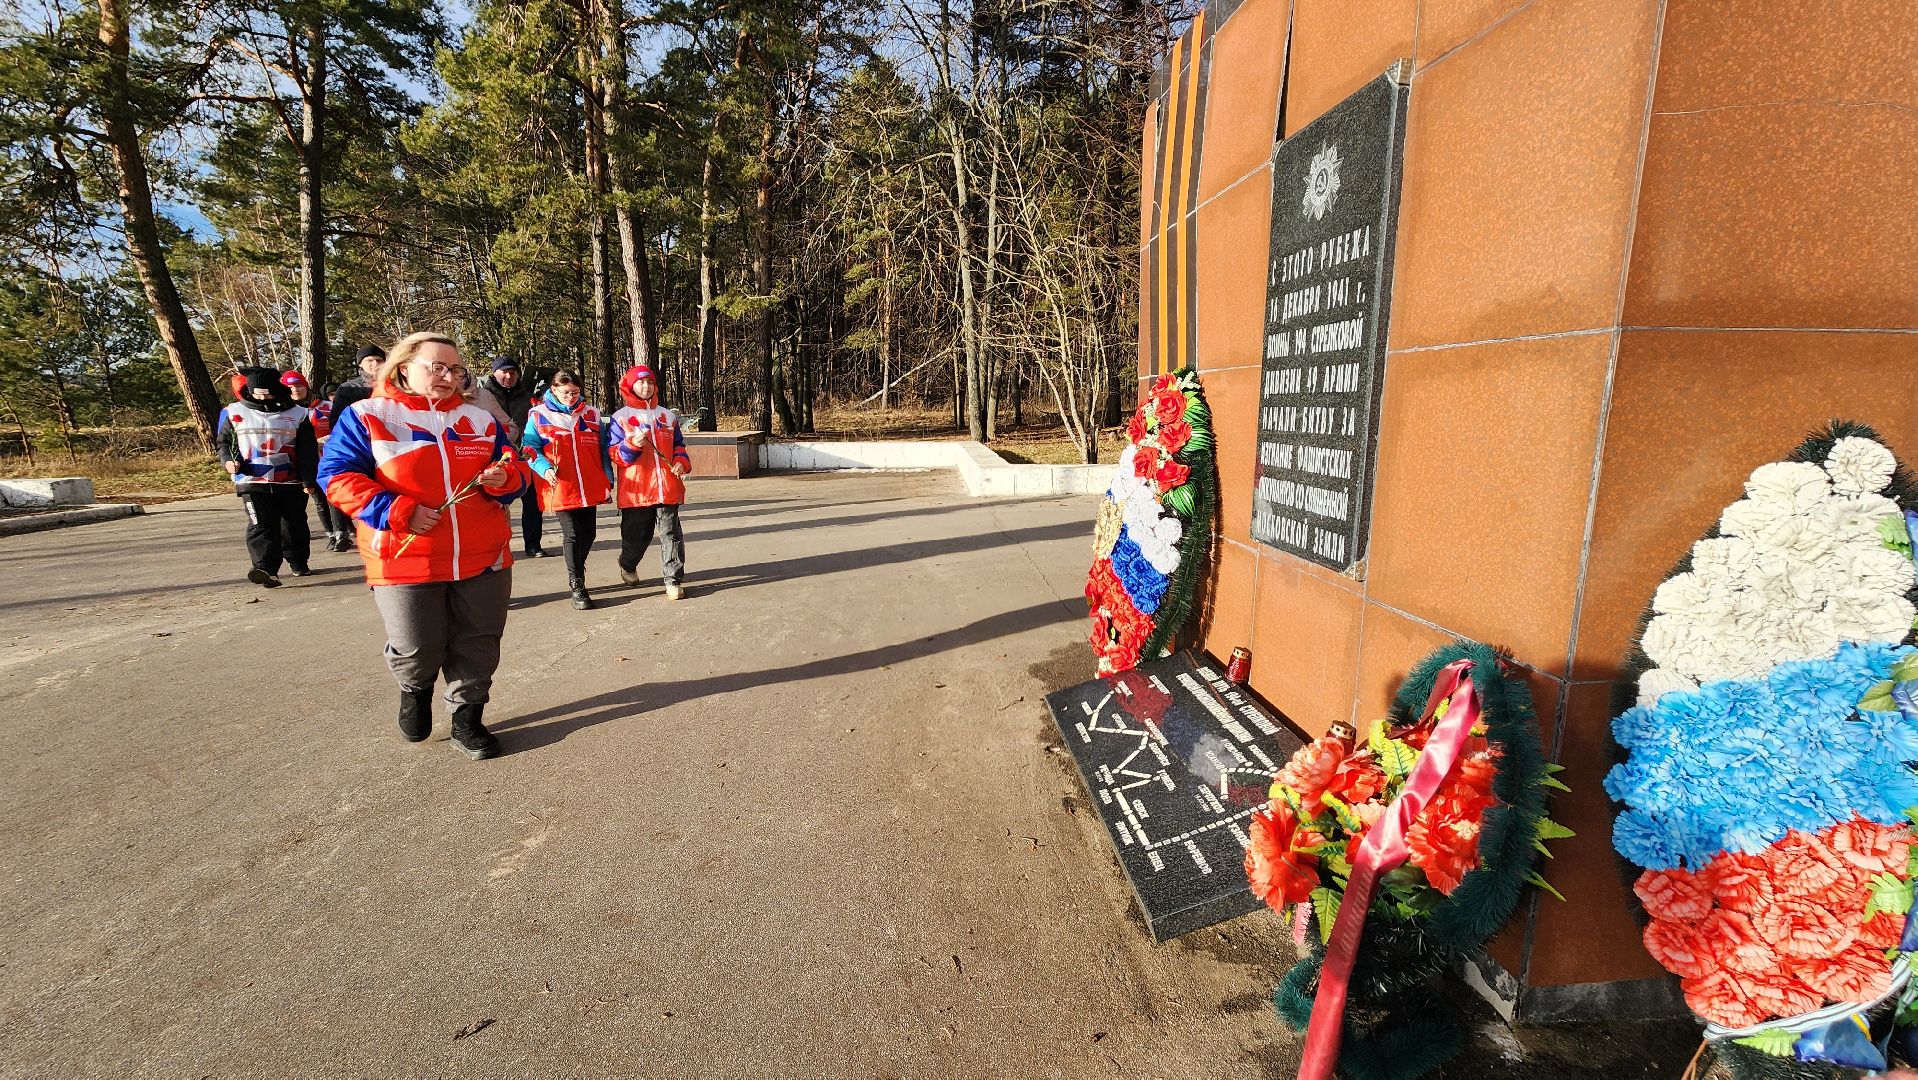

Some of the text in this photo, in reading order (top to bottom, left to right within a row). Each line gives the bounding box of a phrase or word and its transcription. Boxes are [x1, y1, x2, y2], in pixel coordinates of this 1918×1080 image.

[1272, 225, 1370, 286] С ЭТОГО РУБЕЖА
[1270, 297, 1278, 322] 16
[1282, 284, 1320, 324] ДЕКАБРЯ
[1327, 276, 1350, 310] 1941
[1266, 310, 1364, 358] ВОИНЫ 194 СТРЕЛКОВОЙ
[1264, 362, 1360, 400] ДИВИЗИИ 49 АРМИИ
[1262, 406, 1354, 436] НАЧАЛИ БИТВУ ЗА
[1260, 442, 1352, 480] ИЗГНАНИЕ ФАШИСТСКИХ
[1258, 476, 1349, 522] ОККУПАНТОВ СО СВЯЩЕННОЙ
[1256, 510, 1345, 564] МОСКОВСКОЙ ЗЕМЛИ
[1133, 800, 1149, 819] СЕВСК
[1228, 822, 1250, 848] УЗЛОВ
[1184, 840, 1212, 874] ЕФРЕМОВ
